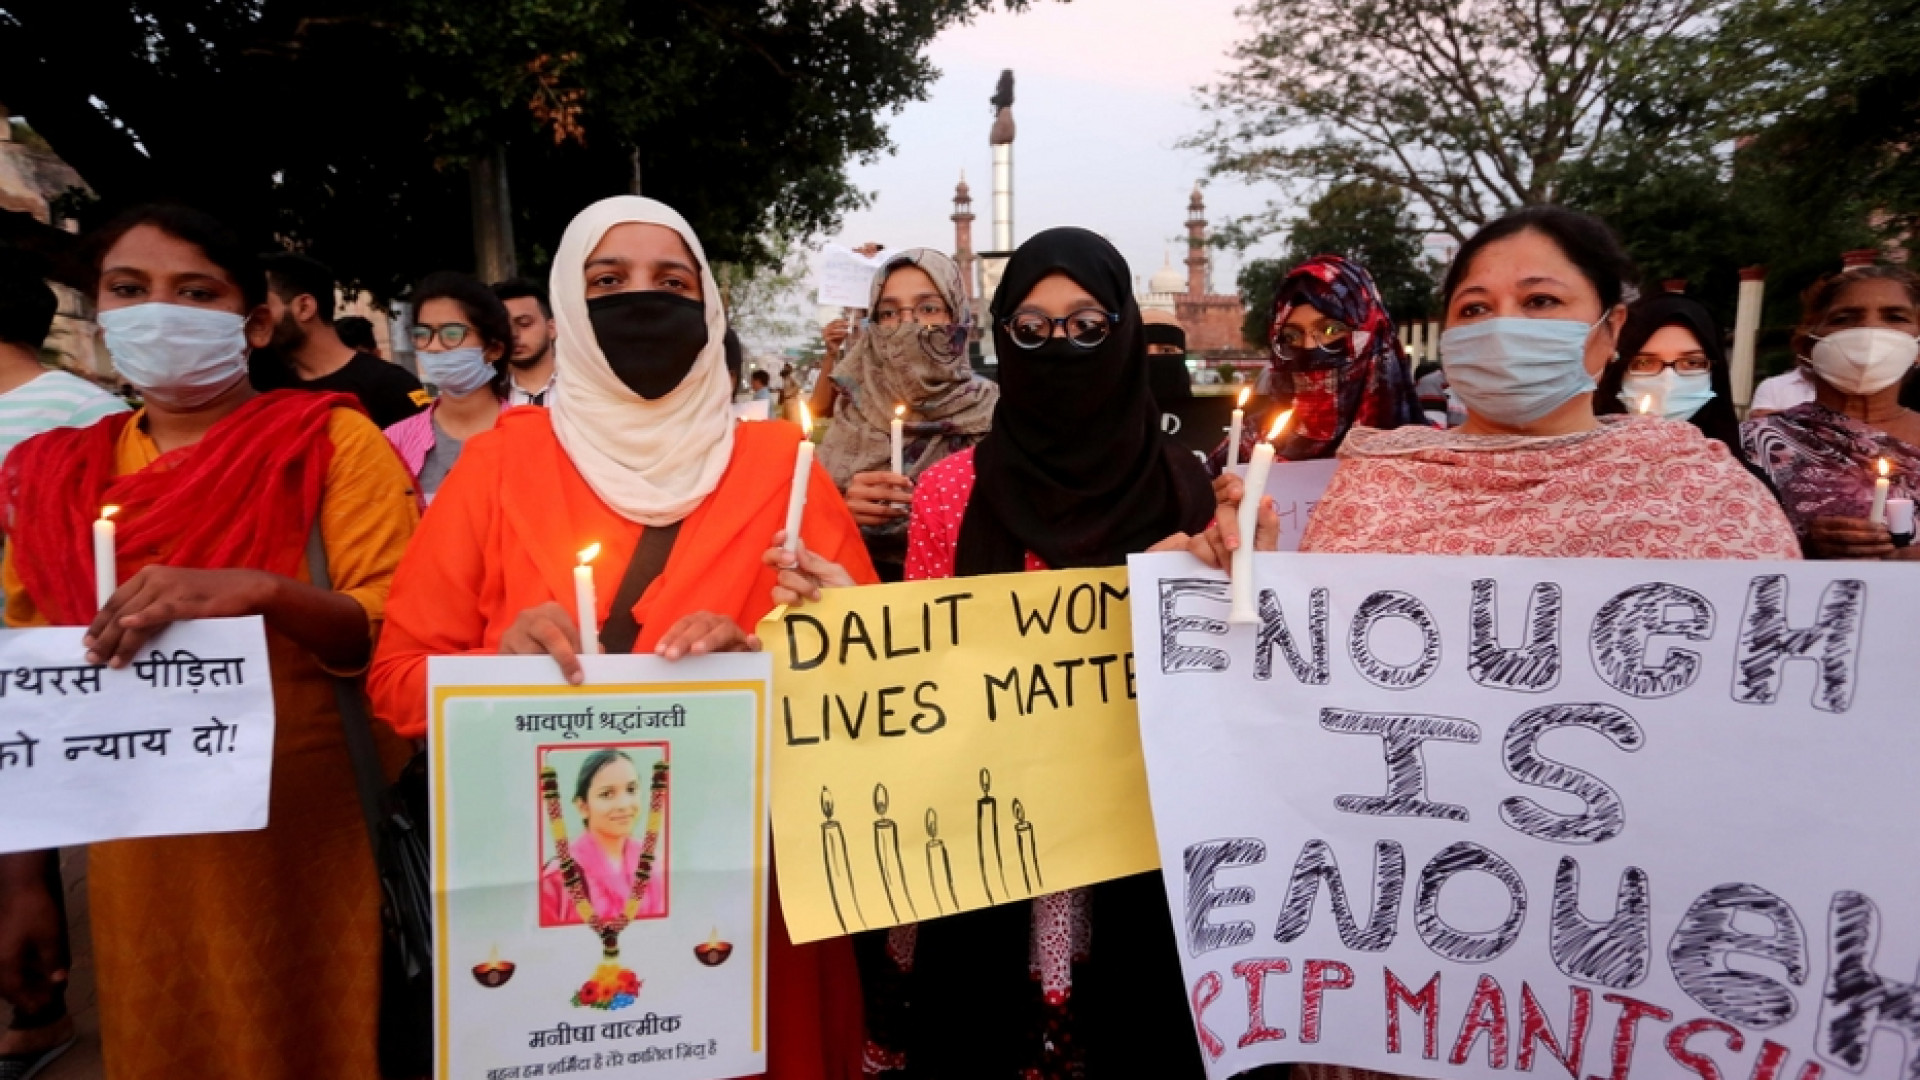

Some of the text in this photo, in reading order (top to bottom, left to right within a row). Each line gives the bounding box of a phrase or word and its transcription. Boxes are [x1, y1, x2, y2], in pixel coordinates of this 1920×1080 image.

[783, 592, 973, 671] DALIT
[132, 649, 246, 694] पीड़िता
[63, 728, 172, 760] न्याय
[192, 716, 239, 756] दो!
[515, 706, 595, 739] भावपूर्ण
[782, 680, 947, 746] LIVES
[1320, 703, 1646, 844] IS
[529, 1021, 597, 1048] मनीषा
[1191, 956, 1355, 1064] RIP
